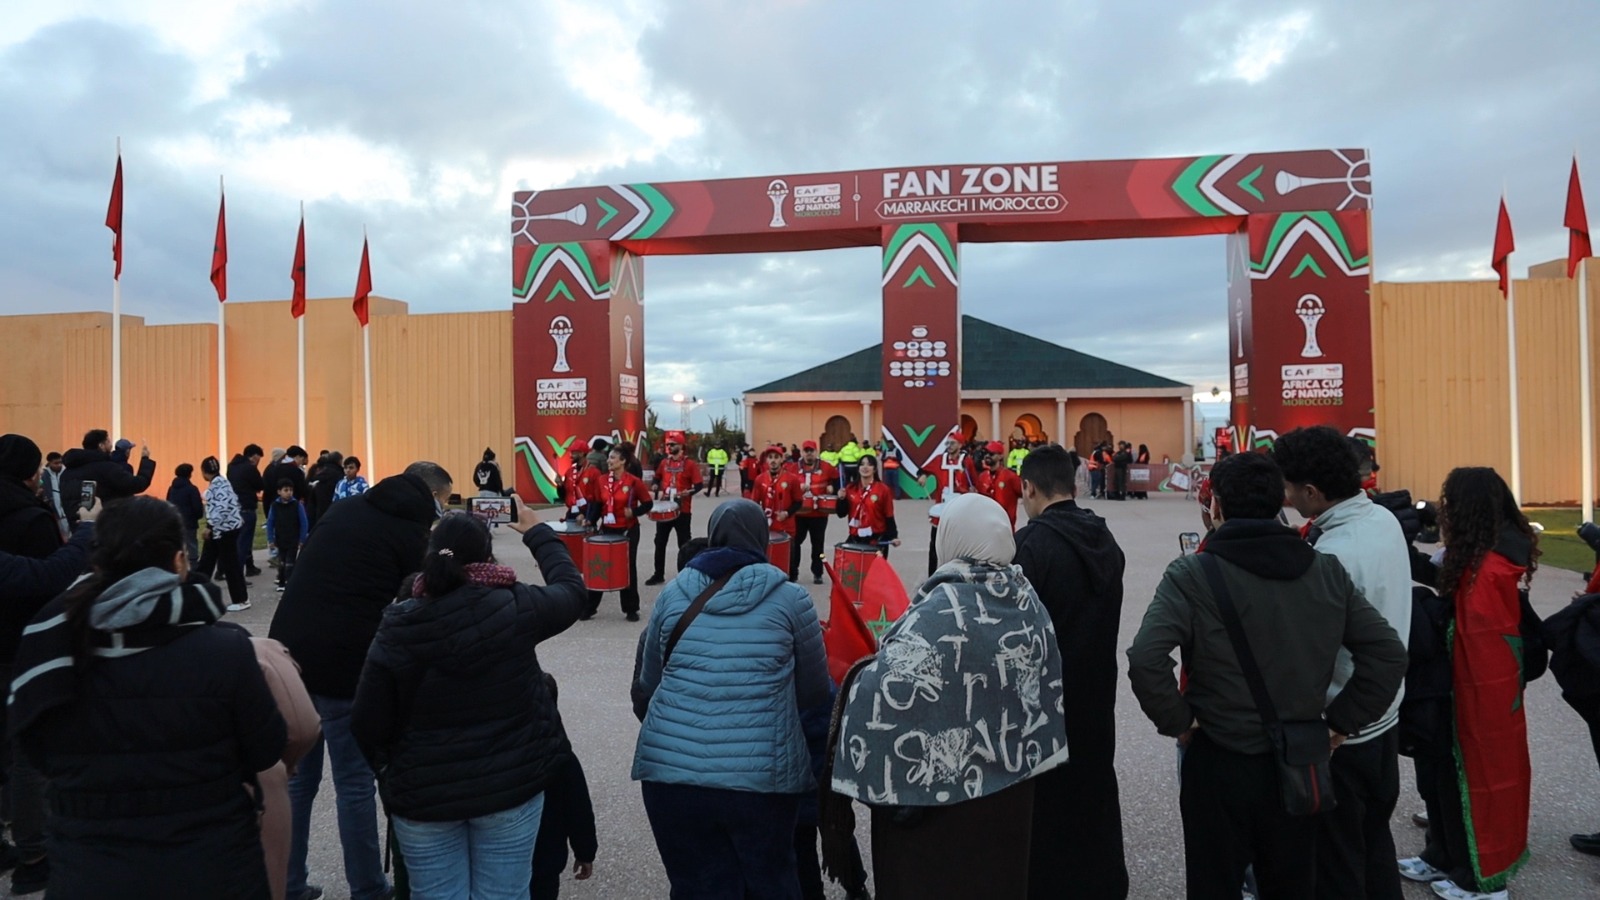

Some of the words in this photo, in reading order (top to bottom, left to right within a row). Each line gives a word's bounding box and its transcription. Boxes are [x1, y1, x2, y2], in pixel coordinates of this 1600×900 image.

[883, 169, 950, 198] FAN
[961, 165, 1059, 194] ZONE
[794, 196, 823, 204] AFRICA
[824, 195, 841, 203] CUP
[794, 204, 806, 212] OF
[806, 202, 841, 211] NATIONS
[883, 199, 968, 215] MARRAKECH
[980, 196, 1059, 211] MOROCCO
[1284, 368, 1315, 377] CAF
[1282, 380, 1320, 389] AFRICA
[1321, 379, 1343, 388] CUP
[537, 392, 568, 401] AFRICA
[569, 391, 587, 400] CUP
[1282, 389, 1297, 399] OF
[1298, 388, 1343, 398] NATIONS
[537, 401, 549, 409] OF
[550, 400, 587, 409] NATIONS
[1282, 398, 1331, 406] MOROCCO
